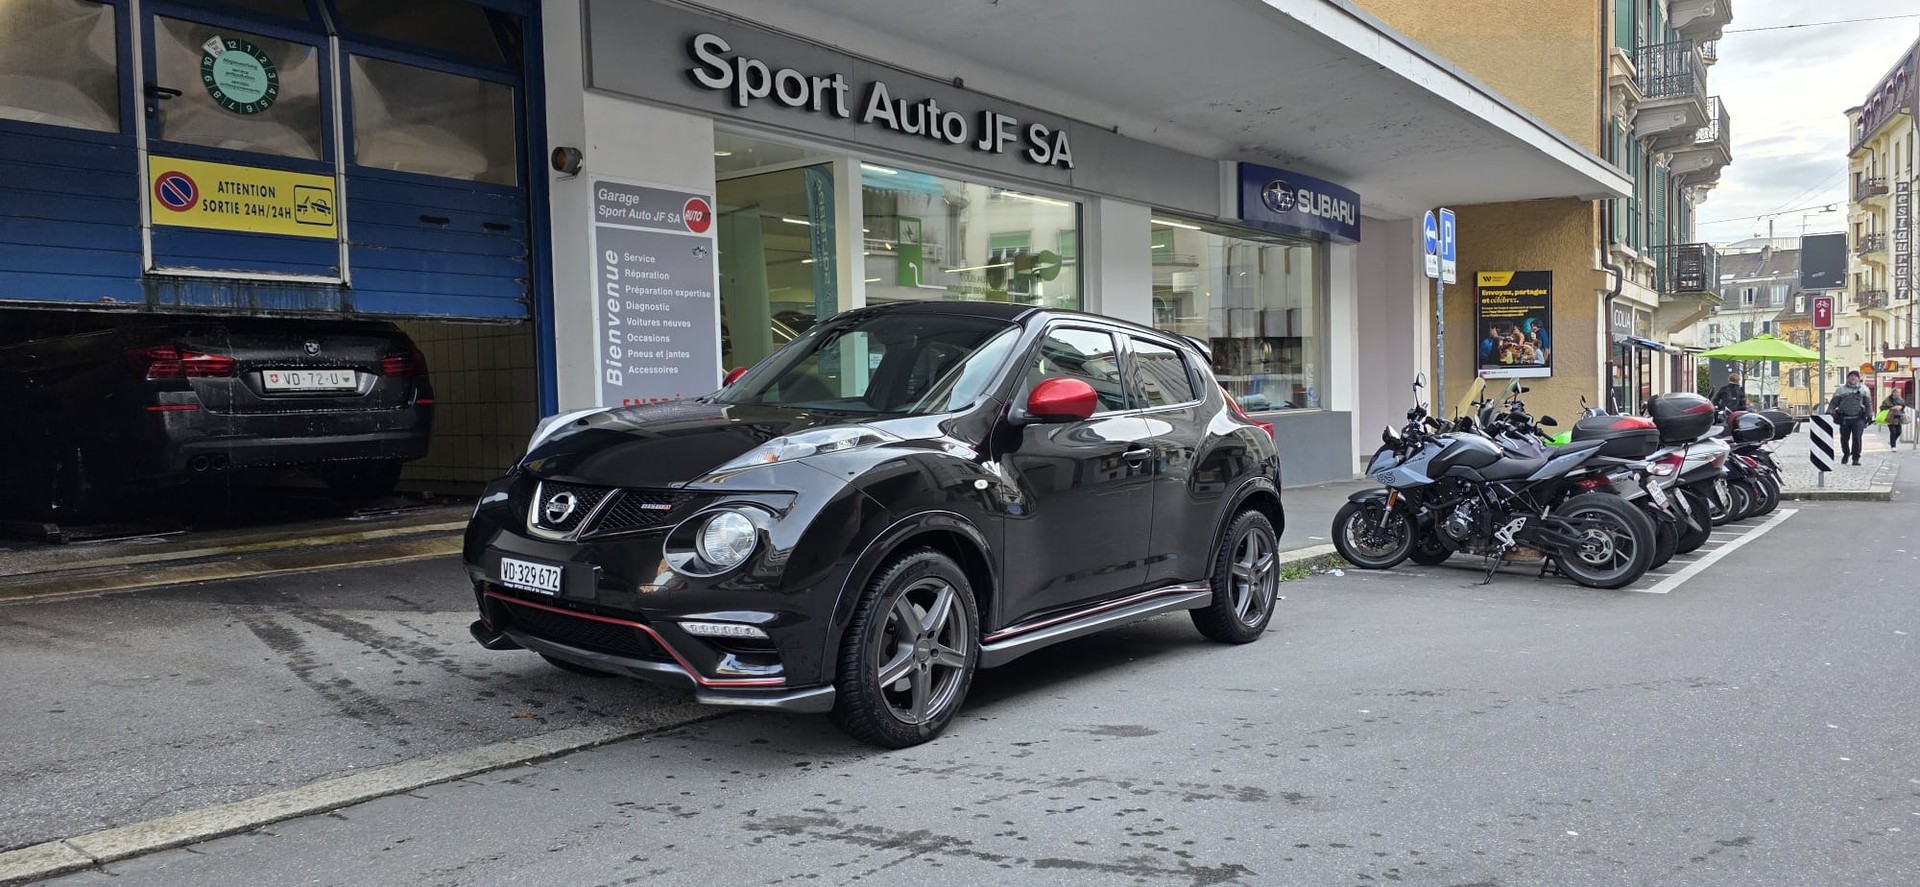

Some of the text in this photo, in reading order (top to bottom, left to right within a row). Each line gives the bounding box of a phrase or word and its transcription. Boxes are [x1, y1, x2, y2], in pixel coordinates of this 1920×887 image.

[227, 40, 238, 48] 12
[204, 56, 212, 66] 10
[691, 33, 1074, 169] Sport Auto JF SA
[218, 181, 276, 198] ATTENTION
[598, 188, 640, 206] Garage
[202, 199, 291, 220] SORTIE 24H/24H
[1297, 188, 1355, 226] SUBARU
[598, 205, 680, 224] Sport Auto JF SA
[1444, 220, 1452, 255] P
[1896, 183, 1908, 298] restaurant
[624, 252, 656, 263] Service
[624, 269, 670, 280] Réparation
[626, 285, 711, 298] Préparation expertise
[626, 301, 670, 312] Diagnostic
[605, 249, 623, 386] Bienvenue
[626, 317, 660, 327] Voitures
[627, 333, 670, 342] Occasions
[628, 349, 654, 358] Pneus
[665, 350, 690, 360] jantes
[629, 365, 678, 374] Accessoires
